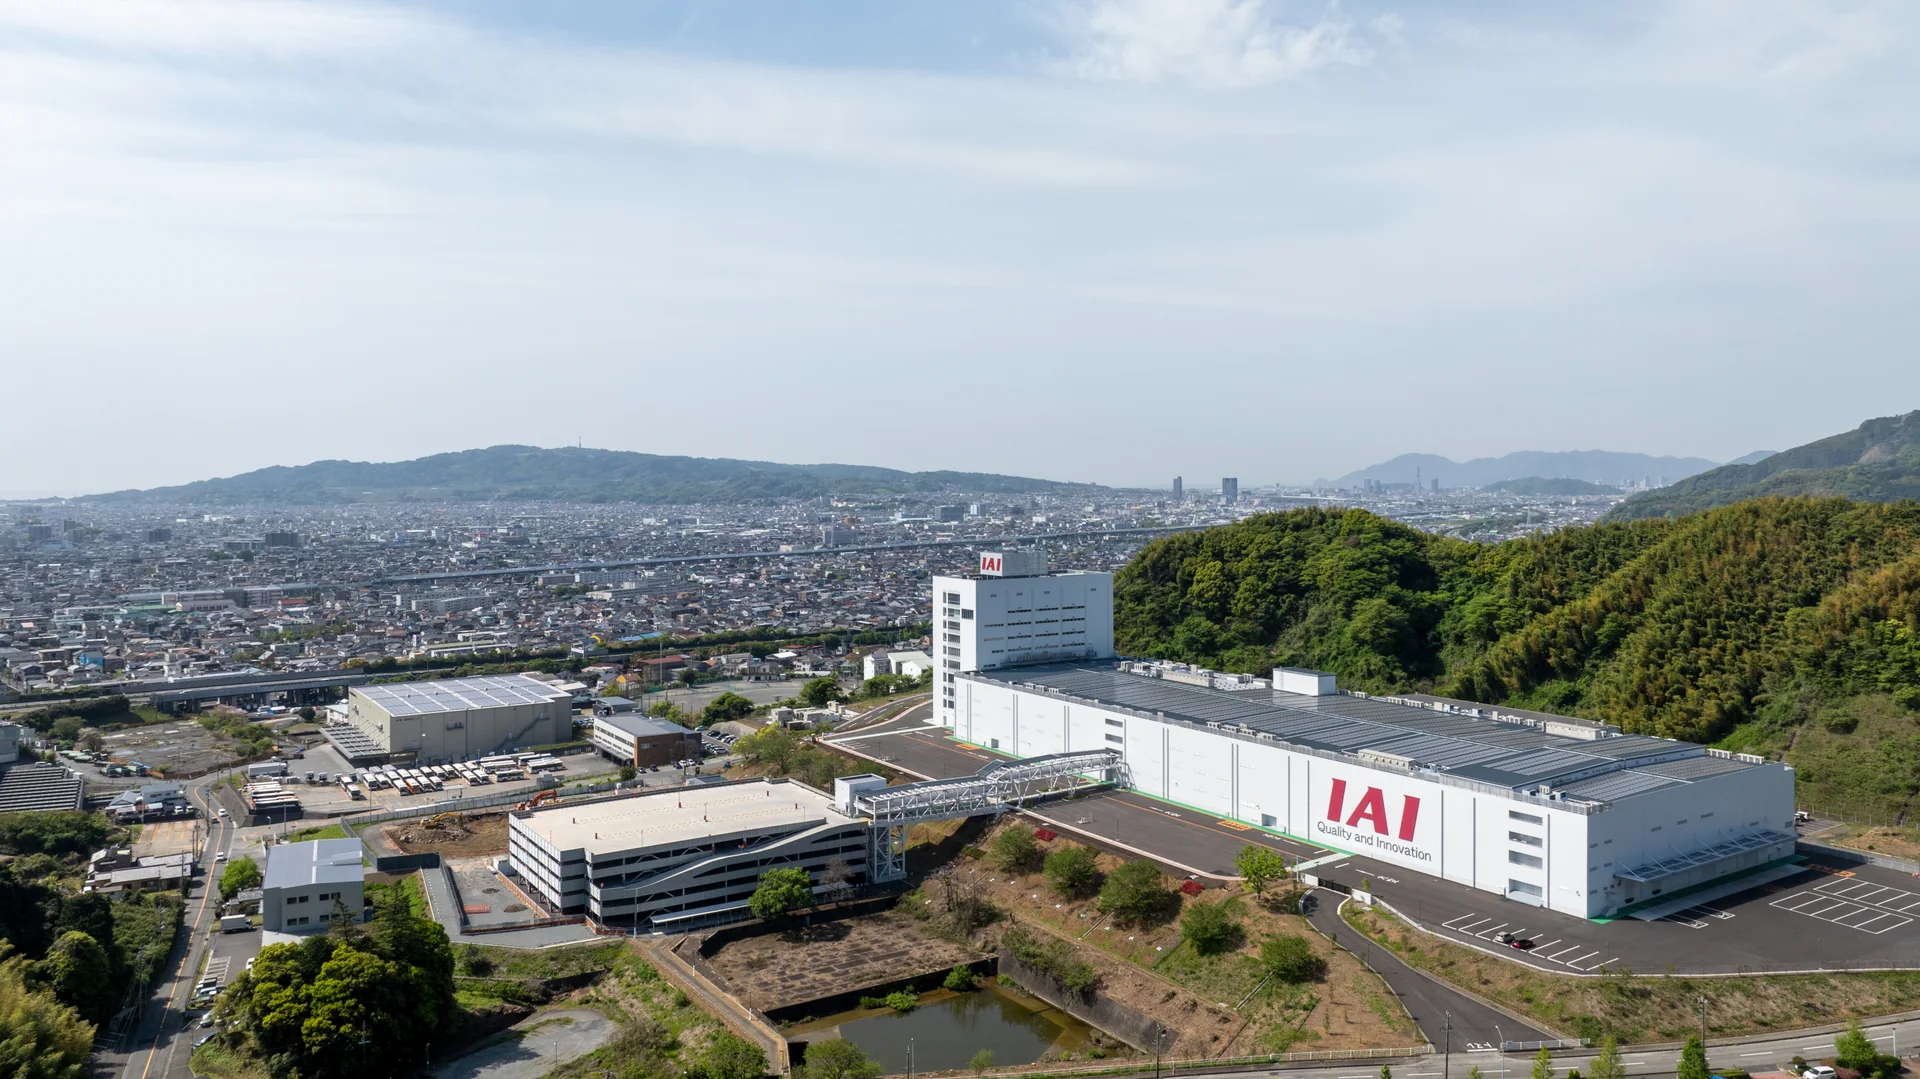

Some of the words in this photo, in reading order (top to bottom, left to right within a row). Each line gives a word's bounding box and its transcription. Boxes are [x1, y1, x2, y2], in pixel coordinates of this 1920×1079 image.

[982, 557, 1001, 571] IAI
[1327, 778, 1420, 842] IAI
[1317, 821, 1352, 840] Quality
[1354, 833, 1374, 846] and
[1376, 837, 1432, 862] Innovation
